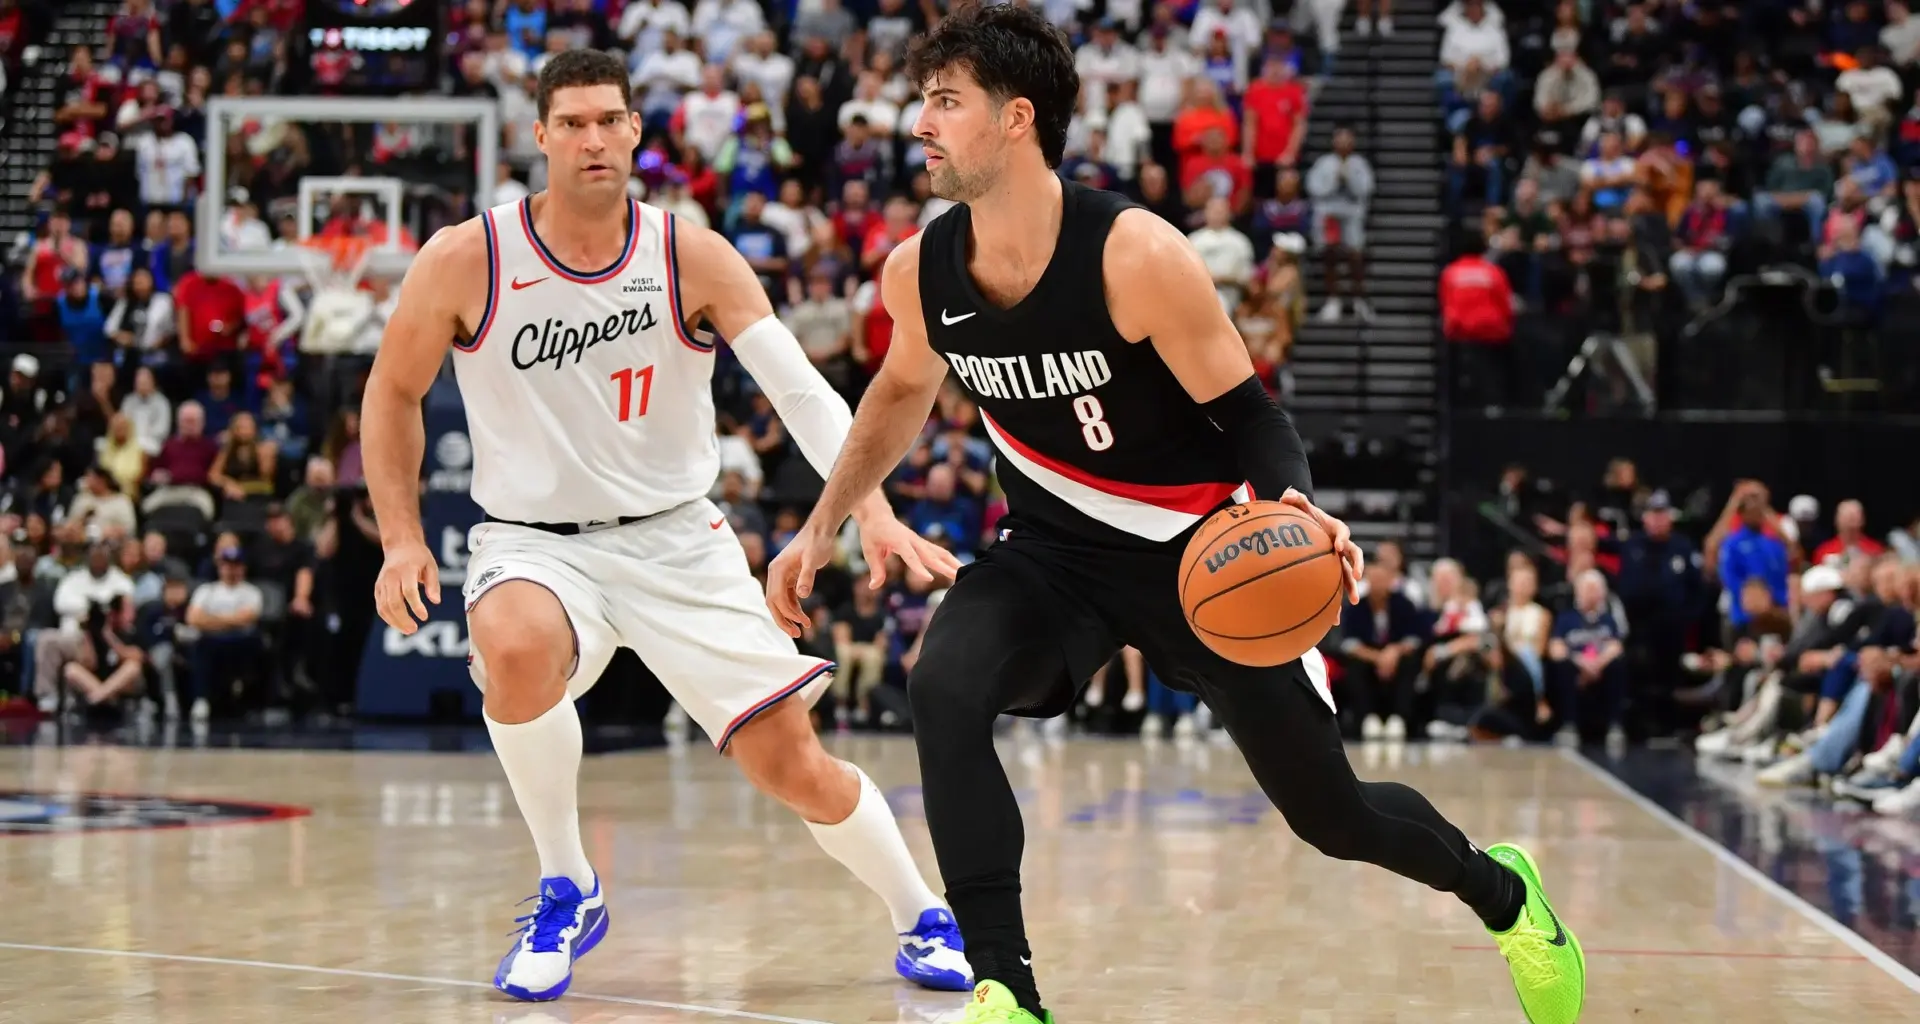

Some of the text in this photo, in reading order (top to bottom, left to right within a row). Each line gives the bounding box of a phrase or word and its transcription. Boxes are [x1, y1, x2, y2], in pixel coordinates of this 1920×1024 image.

[622, 285, 663, 293] RWANDA
[631, 277, 654, 285] VISIT
[511, 302, 657, 371] Clippers
[610, 364, 654, 422] 11
[945, 350, 1112, 399] PORTLAND
[1073, 394, 1114, 451] 8
[1204, 523, 1313, 574] Wilson
